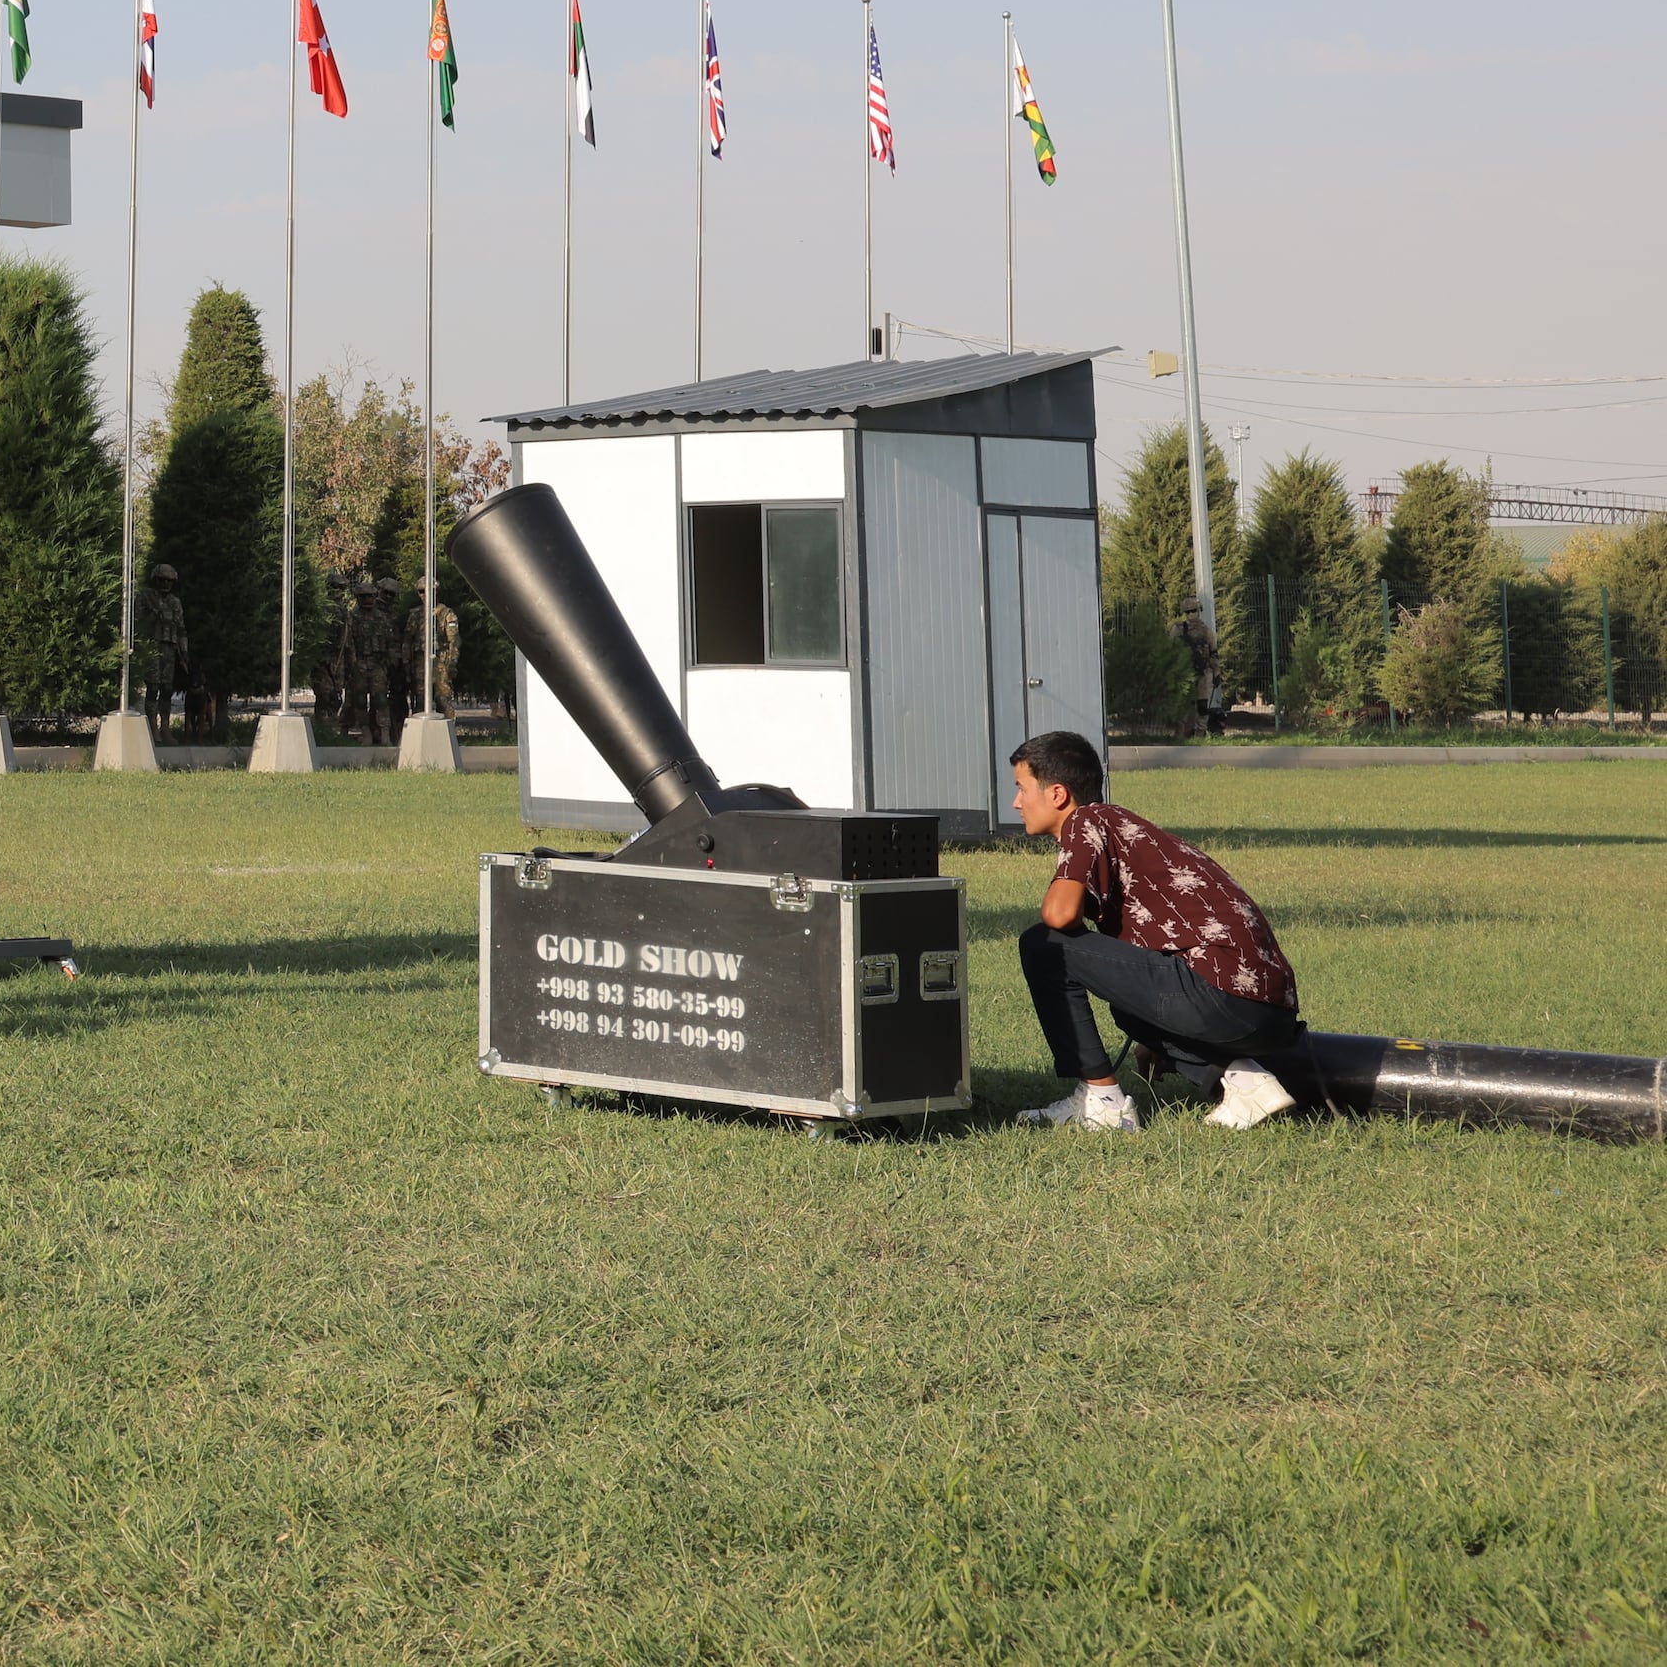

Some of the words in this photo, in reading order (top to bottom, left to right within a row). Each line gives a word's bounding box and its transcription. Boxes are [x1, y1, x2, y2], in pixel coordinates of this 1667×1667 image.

[536, 934, 626, 969] GOLD
[640, 944, 744, 982] SHOW
[536, 976, 590, 1001] +998
[597, 981, 624, 1005] 93
[632, 986, 746, 1020] 580-35-99
[536, 1008, 590, 1033] +998
[597, 1014, 625, 1038] 94
[631, 1018, 746, 1053] 301-09-99
